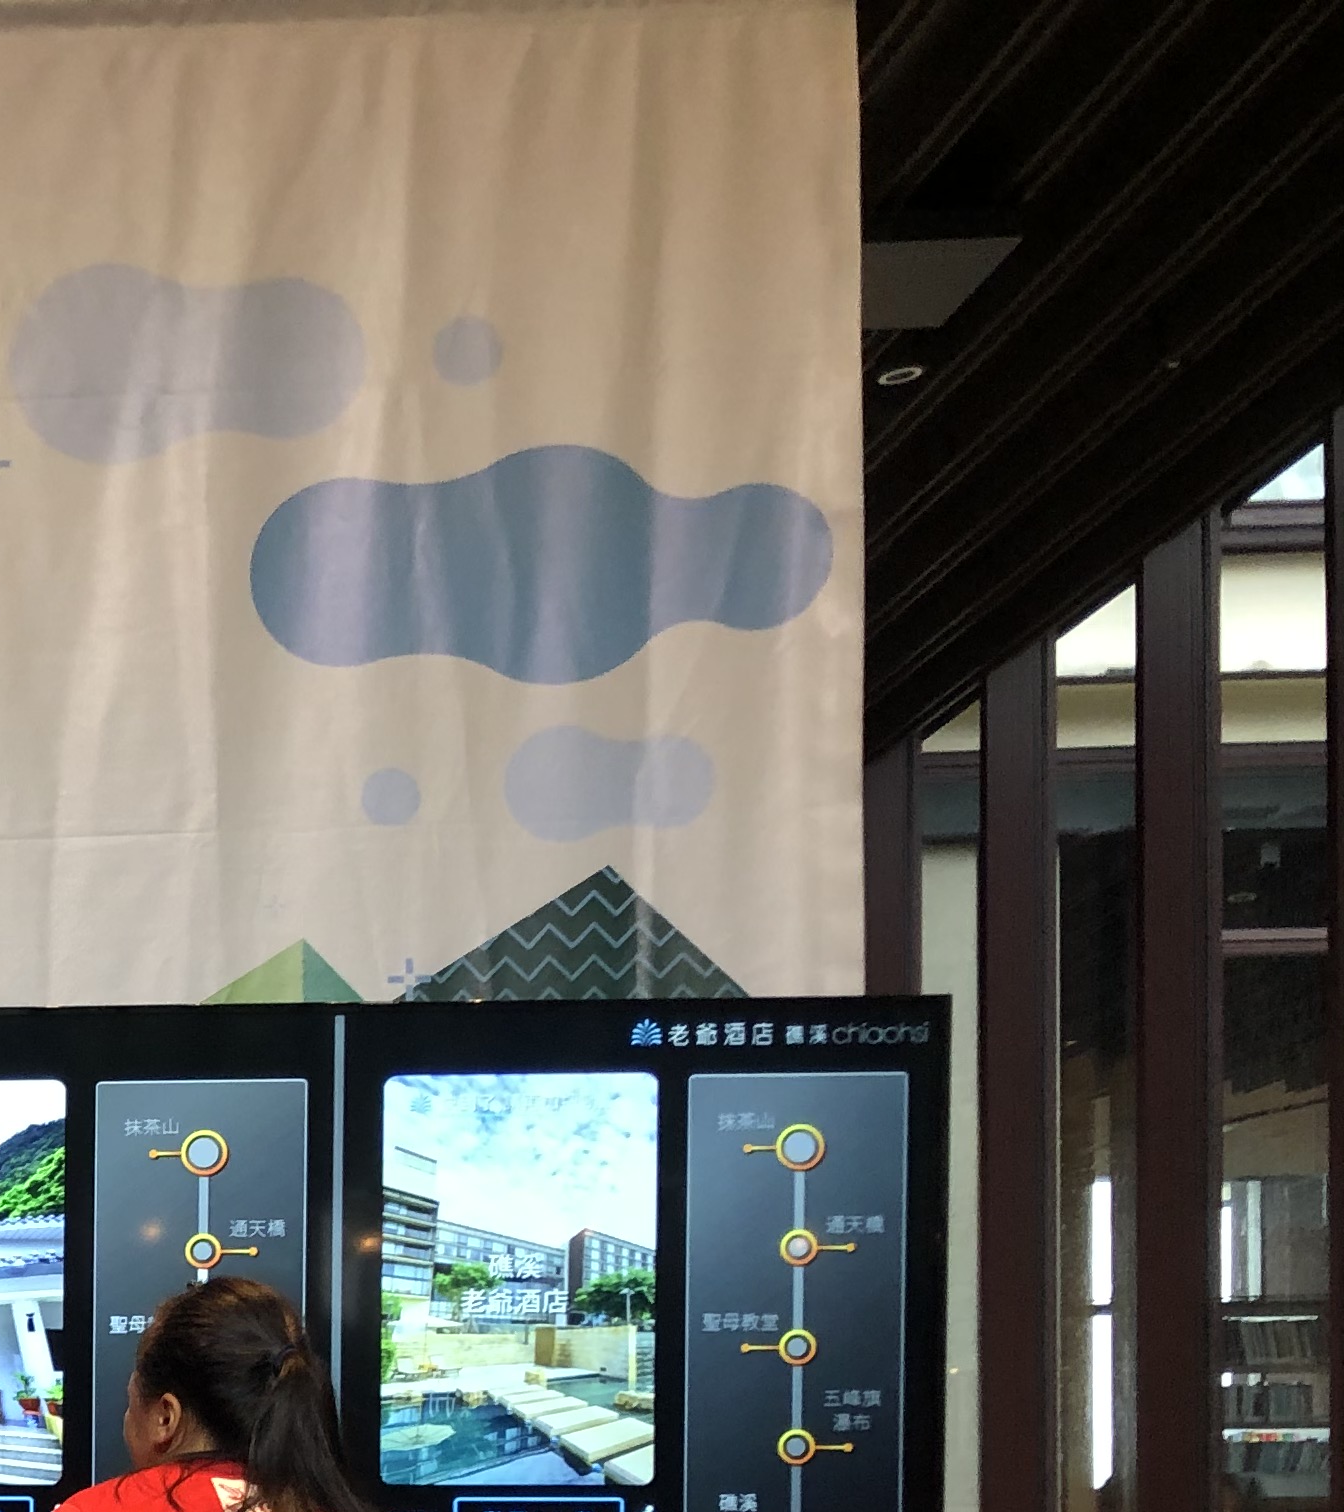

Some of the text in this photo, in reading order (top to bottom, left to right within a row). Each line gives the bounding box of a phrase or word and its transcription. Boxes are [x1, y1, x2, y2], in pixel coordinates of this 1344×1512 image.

[667, 1021, 774, 1047] 老爺酒店
[123, 1118, 180, 1137] 抹茶山
[228, 1218, 287, 1238] 通天橋
[461, 1287, 569, 1315] 老爺酒店
[109, 1315, 154, 1334] 聖母
